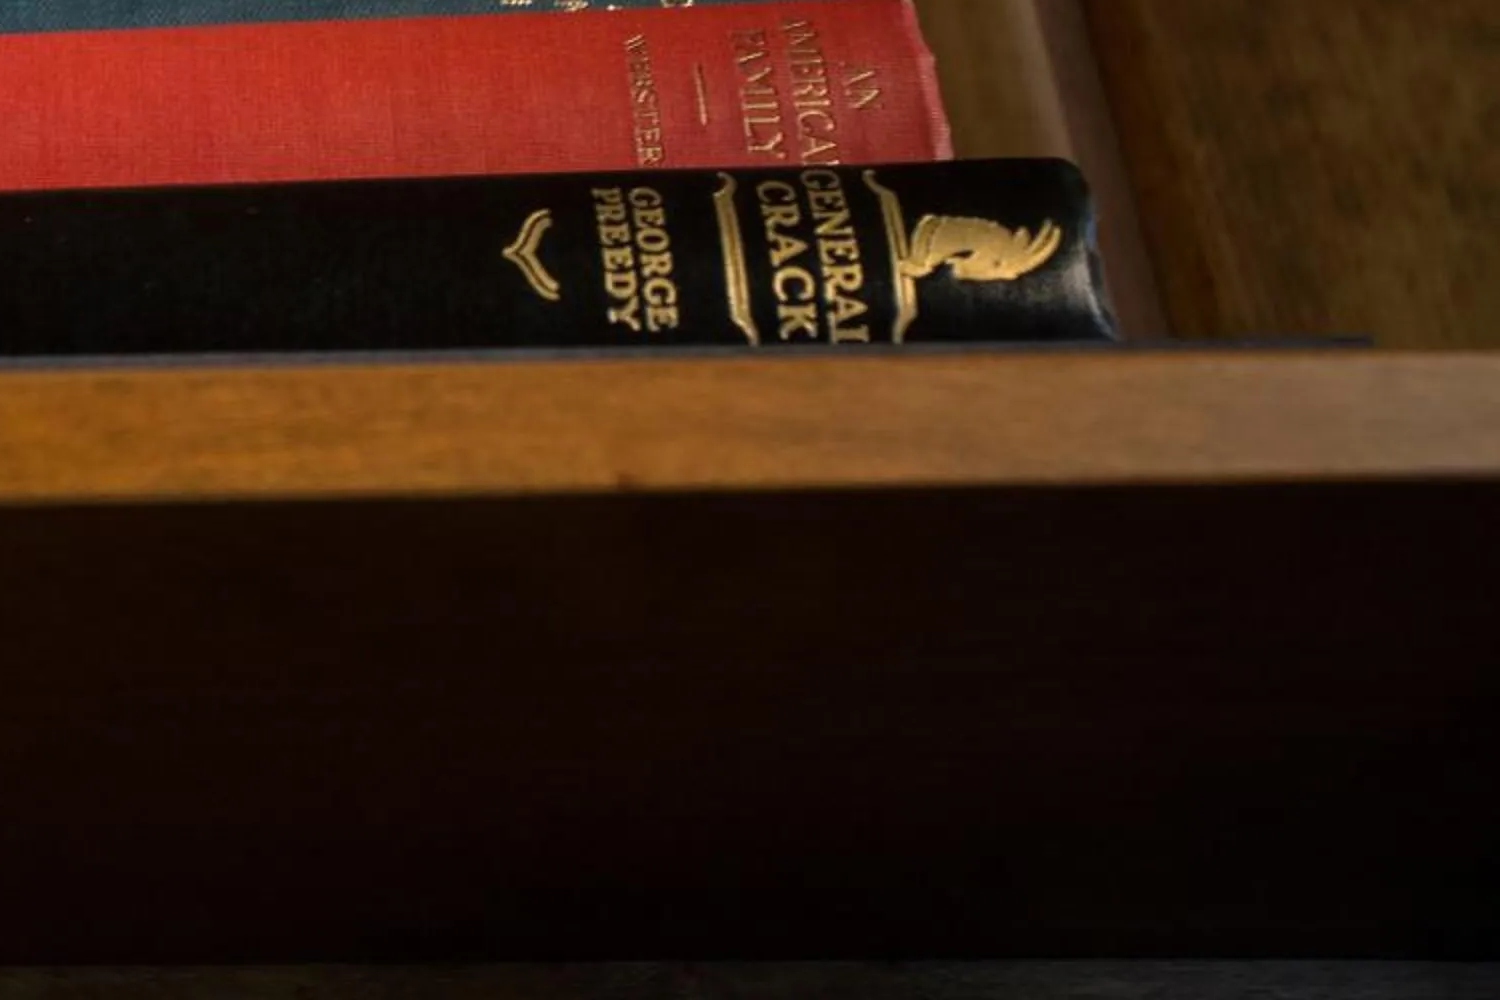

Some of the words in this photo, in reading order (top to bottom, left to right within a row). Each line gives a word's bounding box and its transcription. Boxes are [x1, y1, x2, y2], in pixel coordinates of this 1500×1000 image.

[731, 28, 787, 160] FAMILY
[591, 186, 641, 331] PREEDY
[627, 186, 679, 332] GEORGE
[756, 180, 818, 340] CRACK
